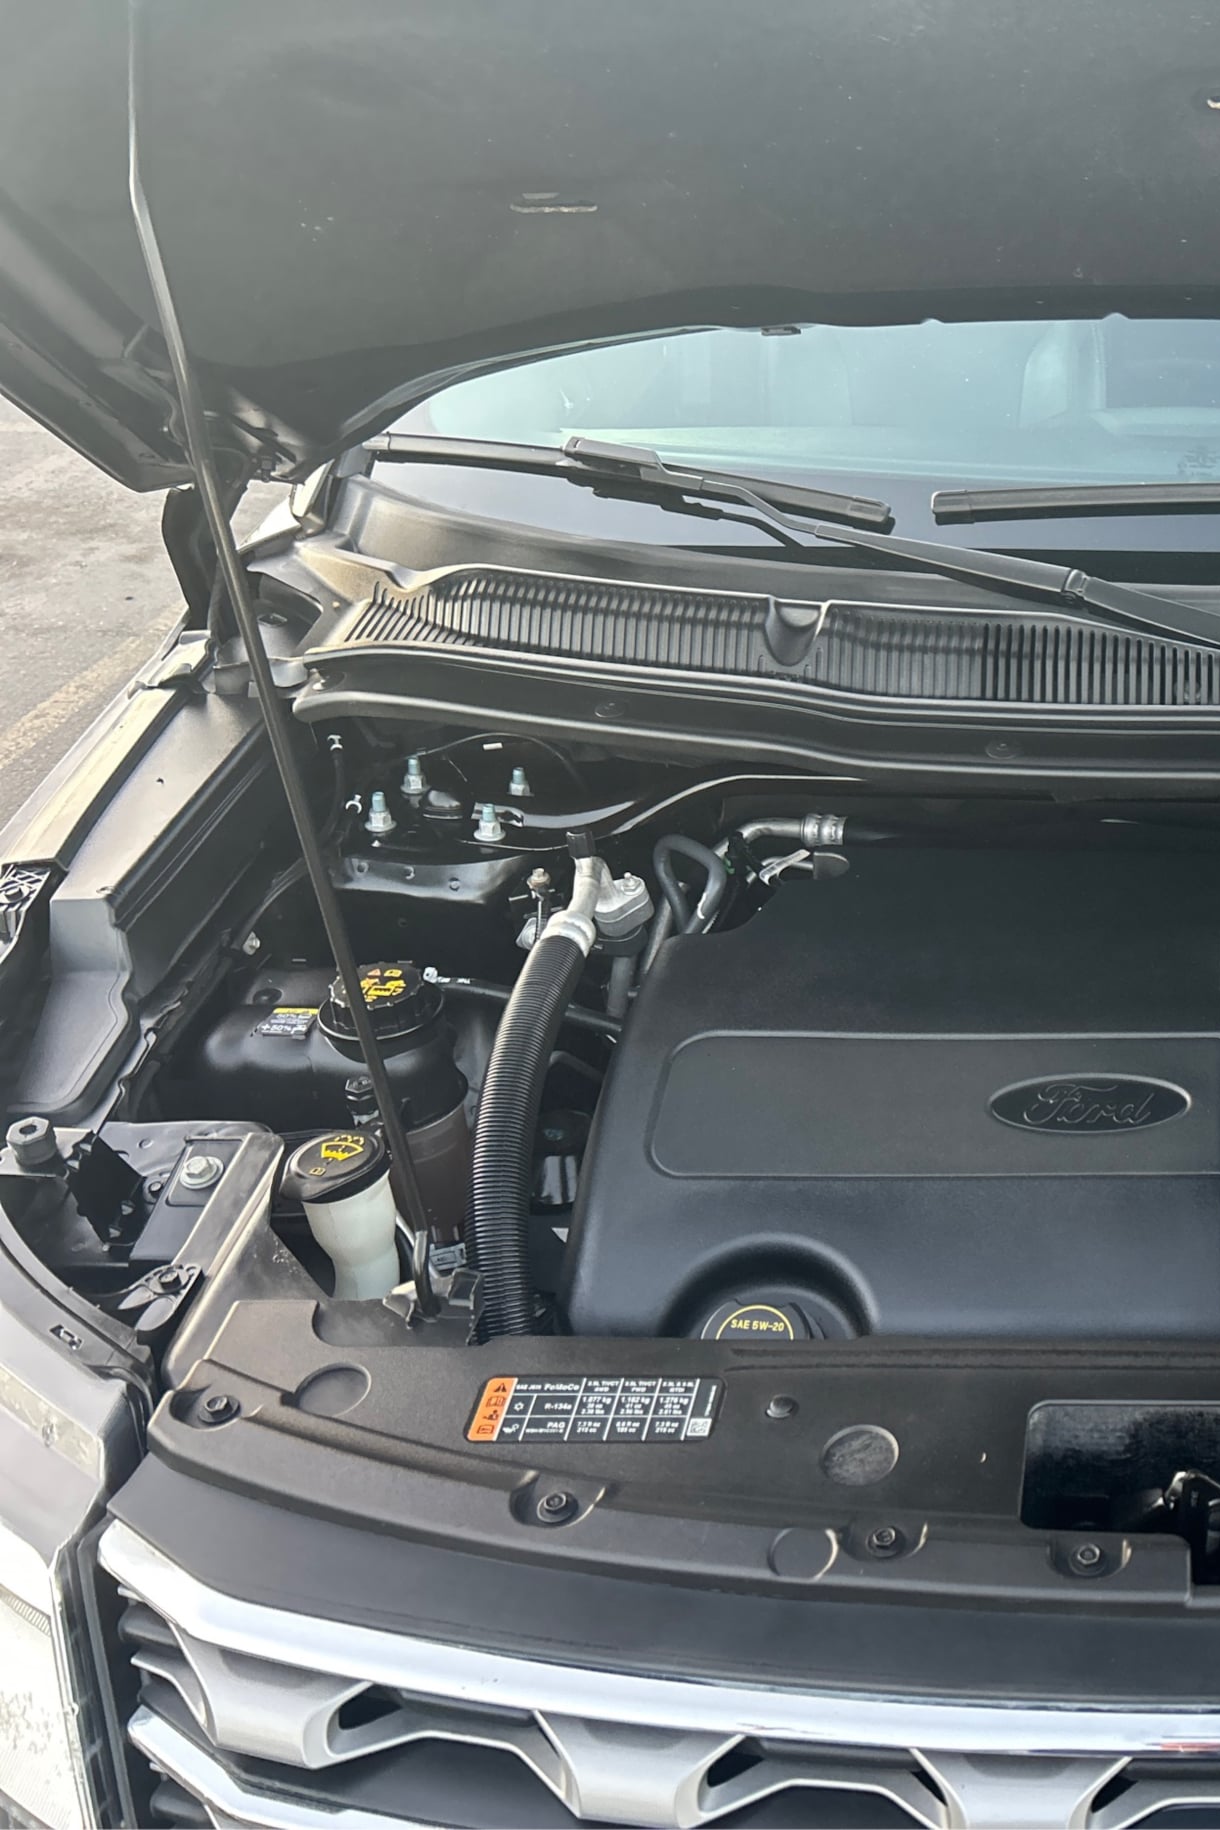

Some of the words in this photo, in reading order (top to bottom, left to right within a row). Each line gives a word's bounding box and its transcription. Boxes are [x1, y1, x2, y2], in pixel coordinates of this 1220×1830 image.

[1023, 1083, 1155, 1124] Ford
[730, 1319, 750, 1329] SAE
[752, 1320, 785, 1332] 5W-20
[544, 1383, 580, 1391] FoMoCo
[602, 1397, 612, 1405] kg
[641, 1397, 651, 1405] kg
[679, 1397, 689, 1405] kg
[547, 1421, 566, 1429] PAG
